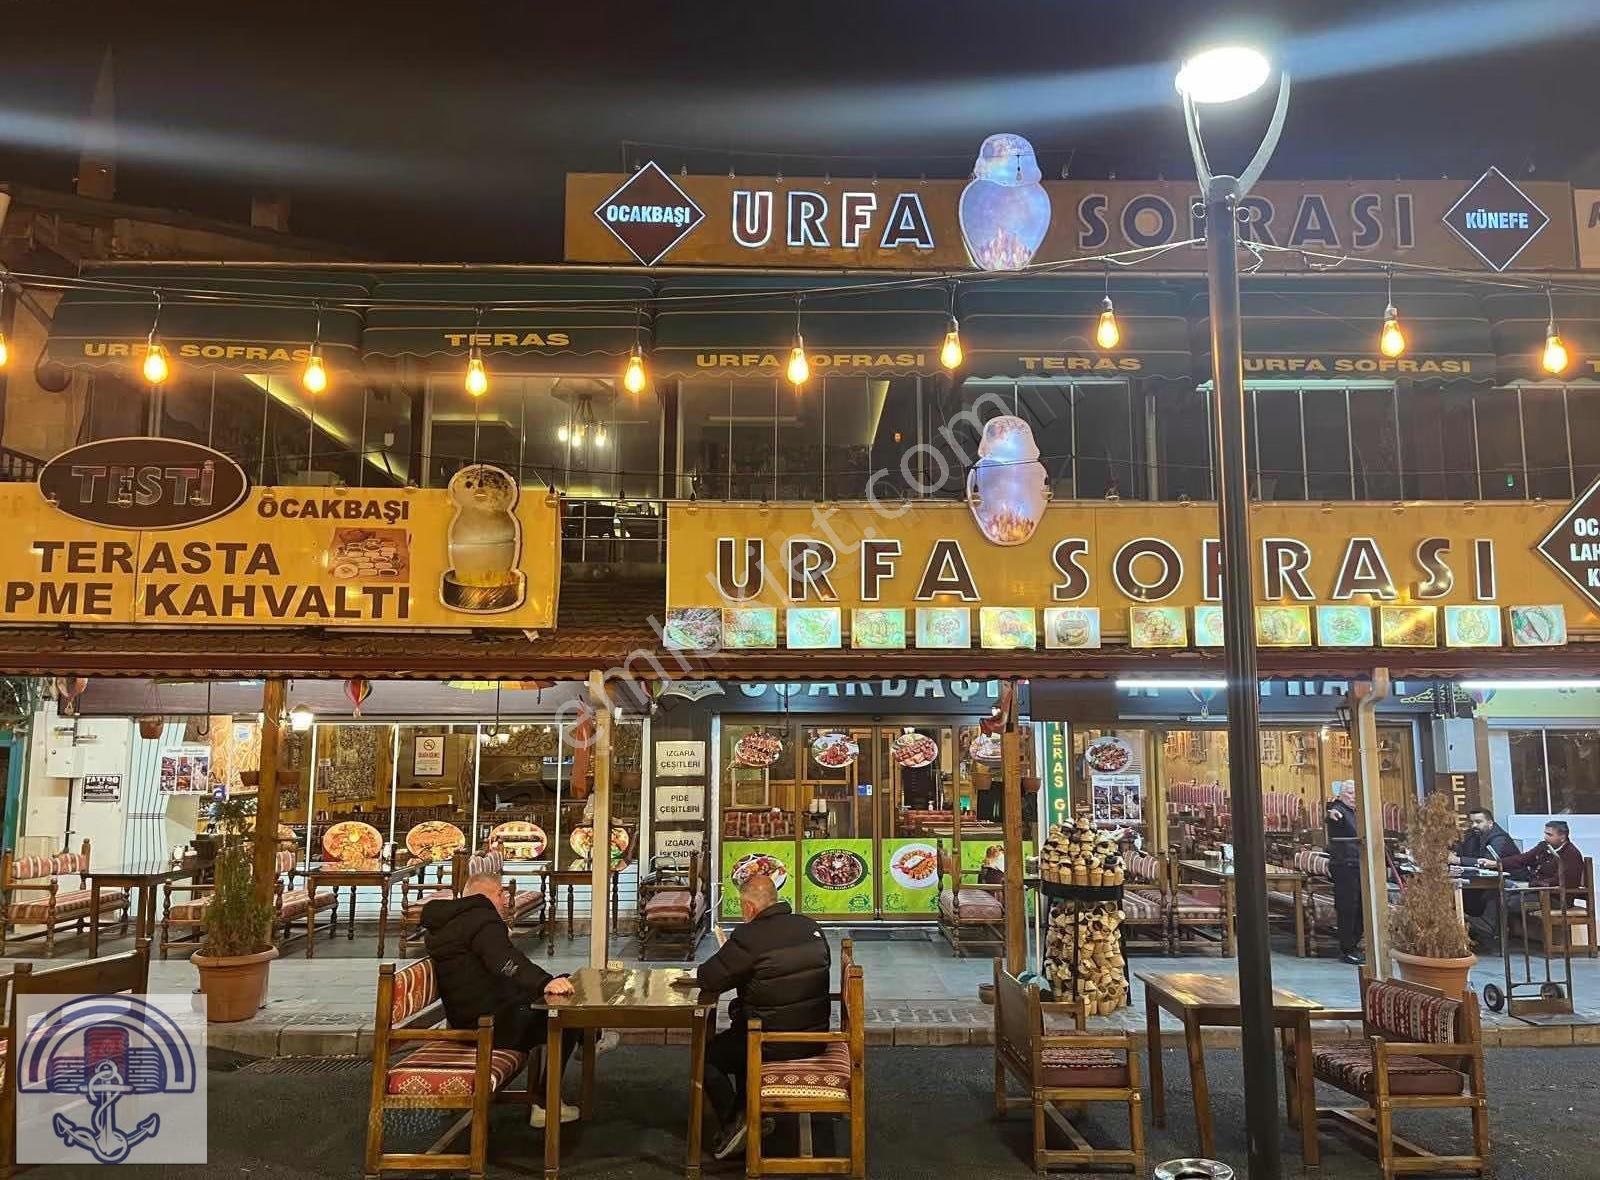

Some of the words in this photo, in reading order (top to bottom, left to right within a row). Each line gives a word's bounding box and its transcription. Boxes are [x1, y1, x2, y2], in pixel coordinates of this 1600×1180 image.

[606, 205, 690, 228] OCAKBAŞI
[732, 191, 935, 249] URFA
[1465, 208, 1529, 229] KÜNEFE
[444, 333, 570, 347] TERAS
[697, 354, 780, 367] URFA
[810, 354, 925, 367] OFRASI
[1018, 356, 1142, 371] TERAS
[1243, 358, 1327, 372] URFA
[1334, 359, 1471, 373] SOFRASI
[71, 459, 215, 506] TESTİ
[1574, 518, 1600, 537] OC
[32, 541, 281, 576] TERASTA
[716, 537, 981, 602] URFA
[5, 581, 113, 615] PME
[144, 583, 409, 619] KAHVALTI
